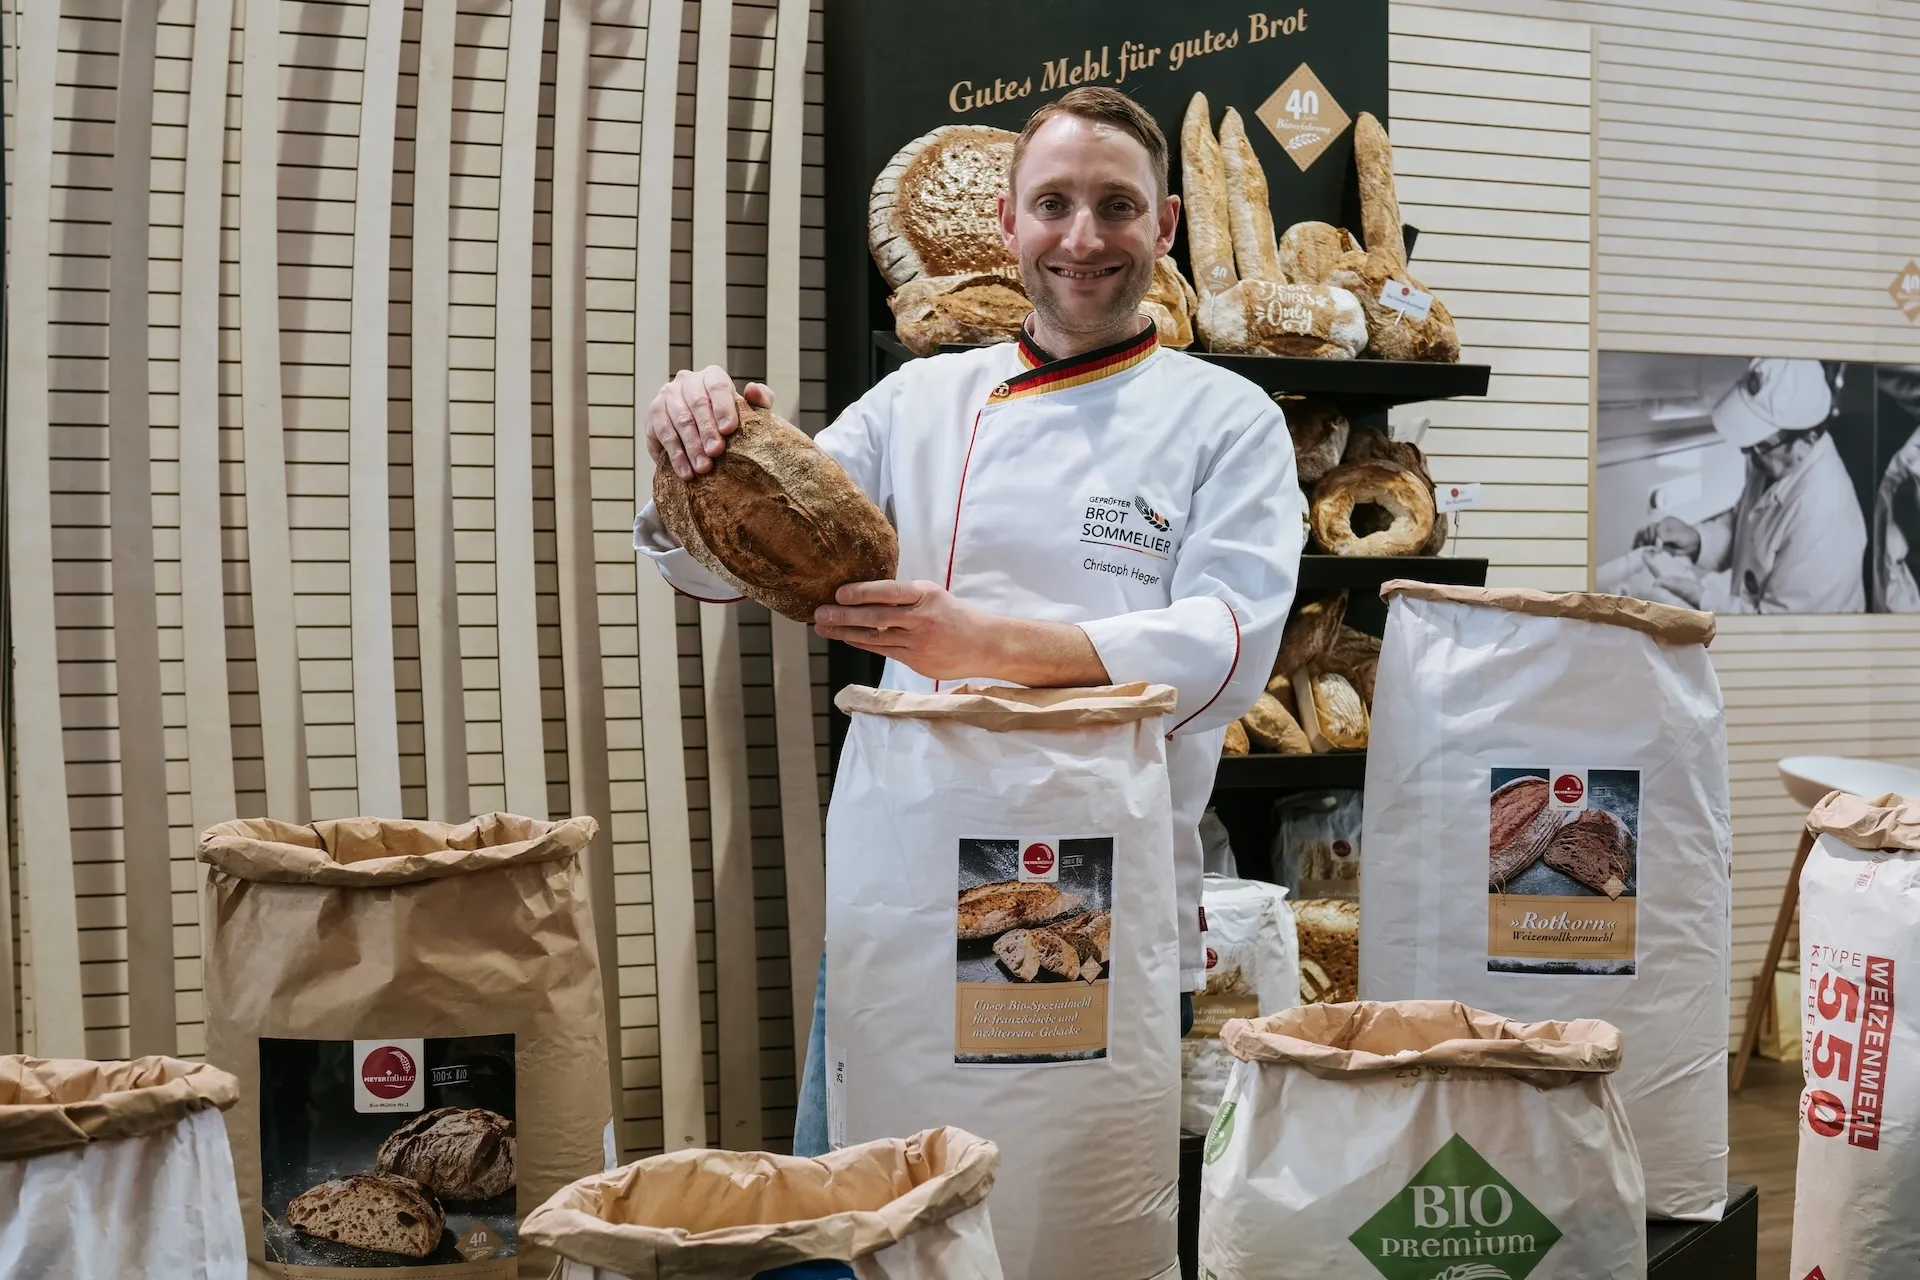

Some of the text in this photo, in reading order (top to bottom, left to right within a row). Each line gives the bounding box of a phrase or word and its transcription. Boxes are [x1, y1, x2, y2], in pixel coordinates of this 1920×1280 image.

[949, 8, 1308, 113] Gutes Mehl für gutes Brot
[1285, 89, 1319, 120] 40
[1089, 496, 1131, 508] GEPRÜFTER
[1085, 507, 1128, 524] BROT
[1082, 523, 1171, 554] SOMMELIER
[1083, 558, 1160, 585] Christoph Heger
[1823, 946, 1861, 968] TYPE
[974, 1000, 1006, 1010] Unser
[970, 1013, 989, 1026] für
[1058, 1011, 1080, 1022] und
[1808, 972, 1860, 1137] 550
[1853, 962, 1889, 1144] WEIZENMEHL
[433, 1068, 468, 1082] 100% BIO
[837, 1062, 845, 1083] 25 kg
[1408, 1184, 1513, 1228] BIO
